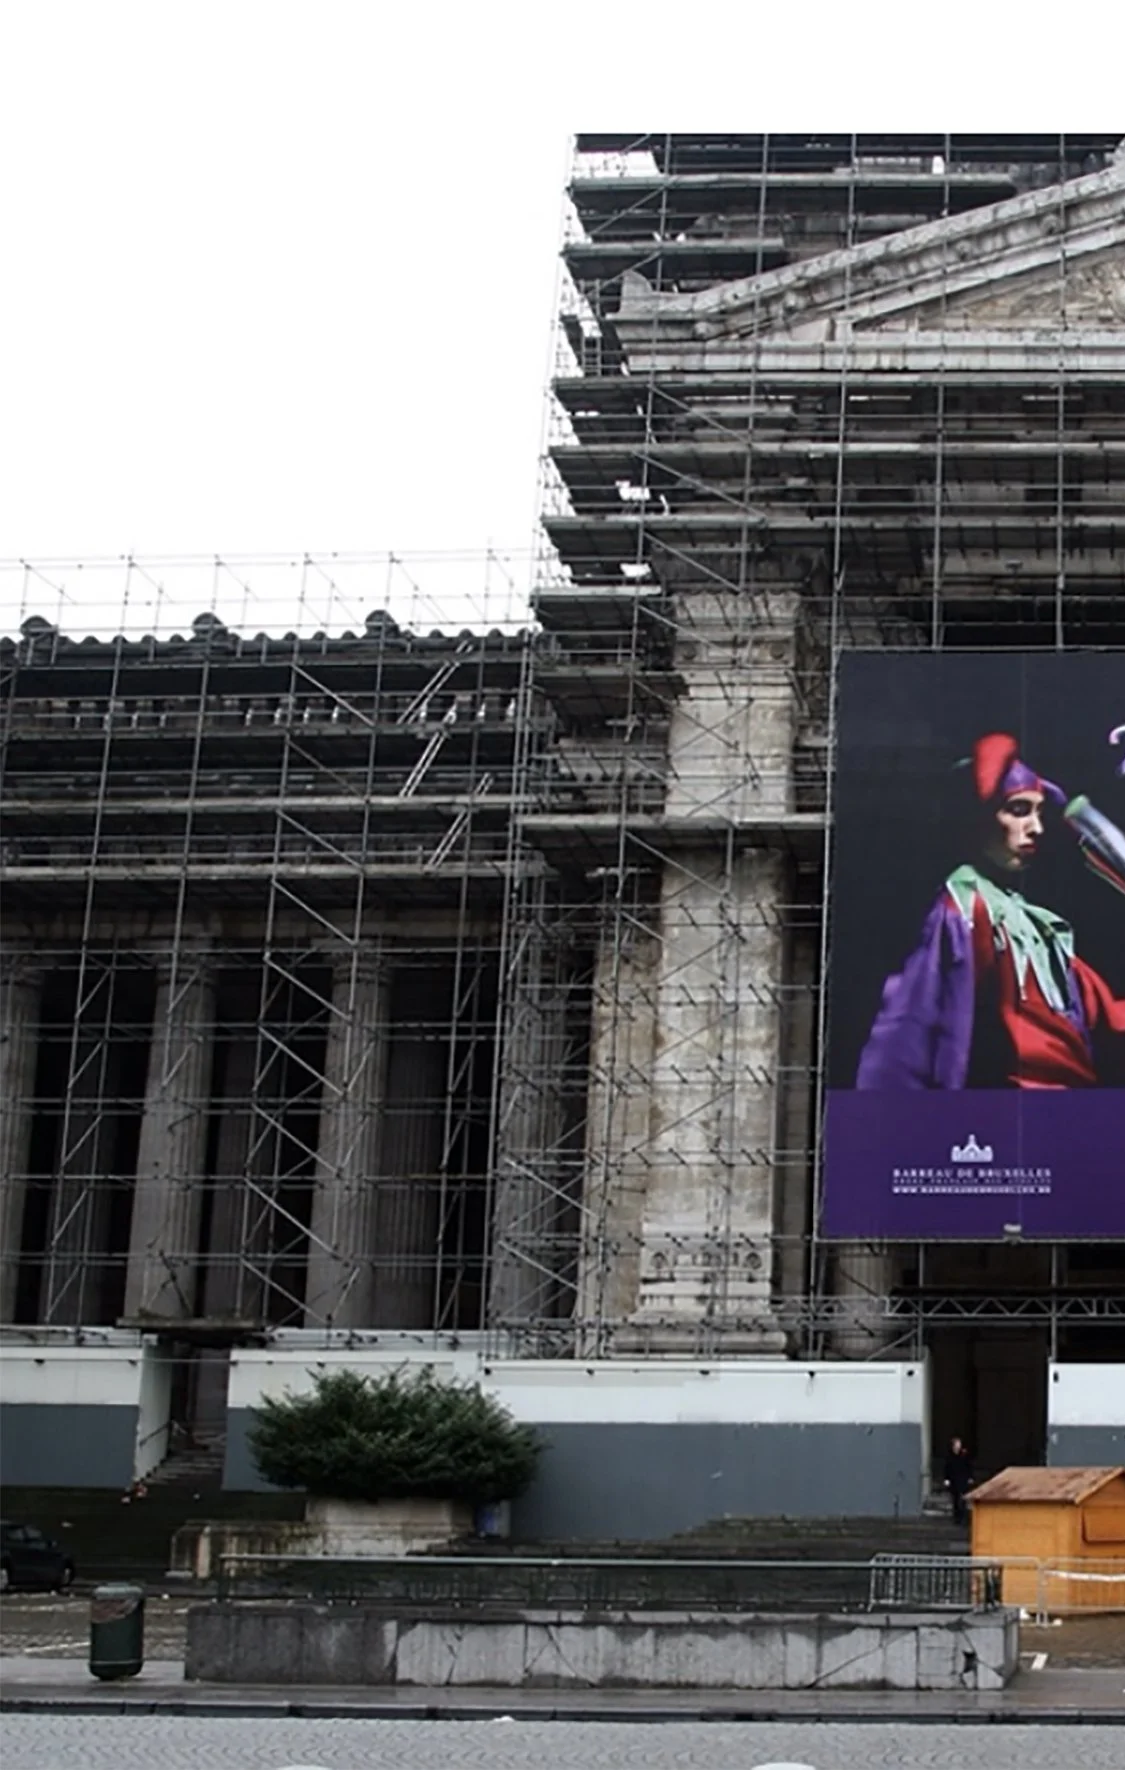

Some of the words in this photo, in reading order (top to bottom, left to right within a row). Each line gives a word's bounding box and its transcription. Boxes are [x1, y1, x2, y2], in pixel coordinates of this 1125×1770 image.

[893, 1168, 953, 1178] BARREAU
[957, 1168, 973, 1178] DE
[978, 1168, 1052, 1178] BRUXELLES
